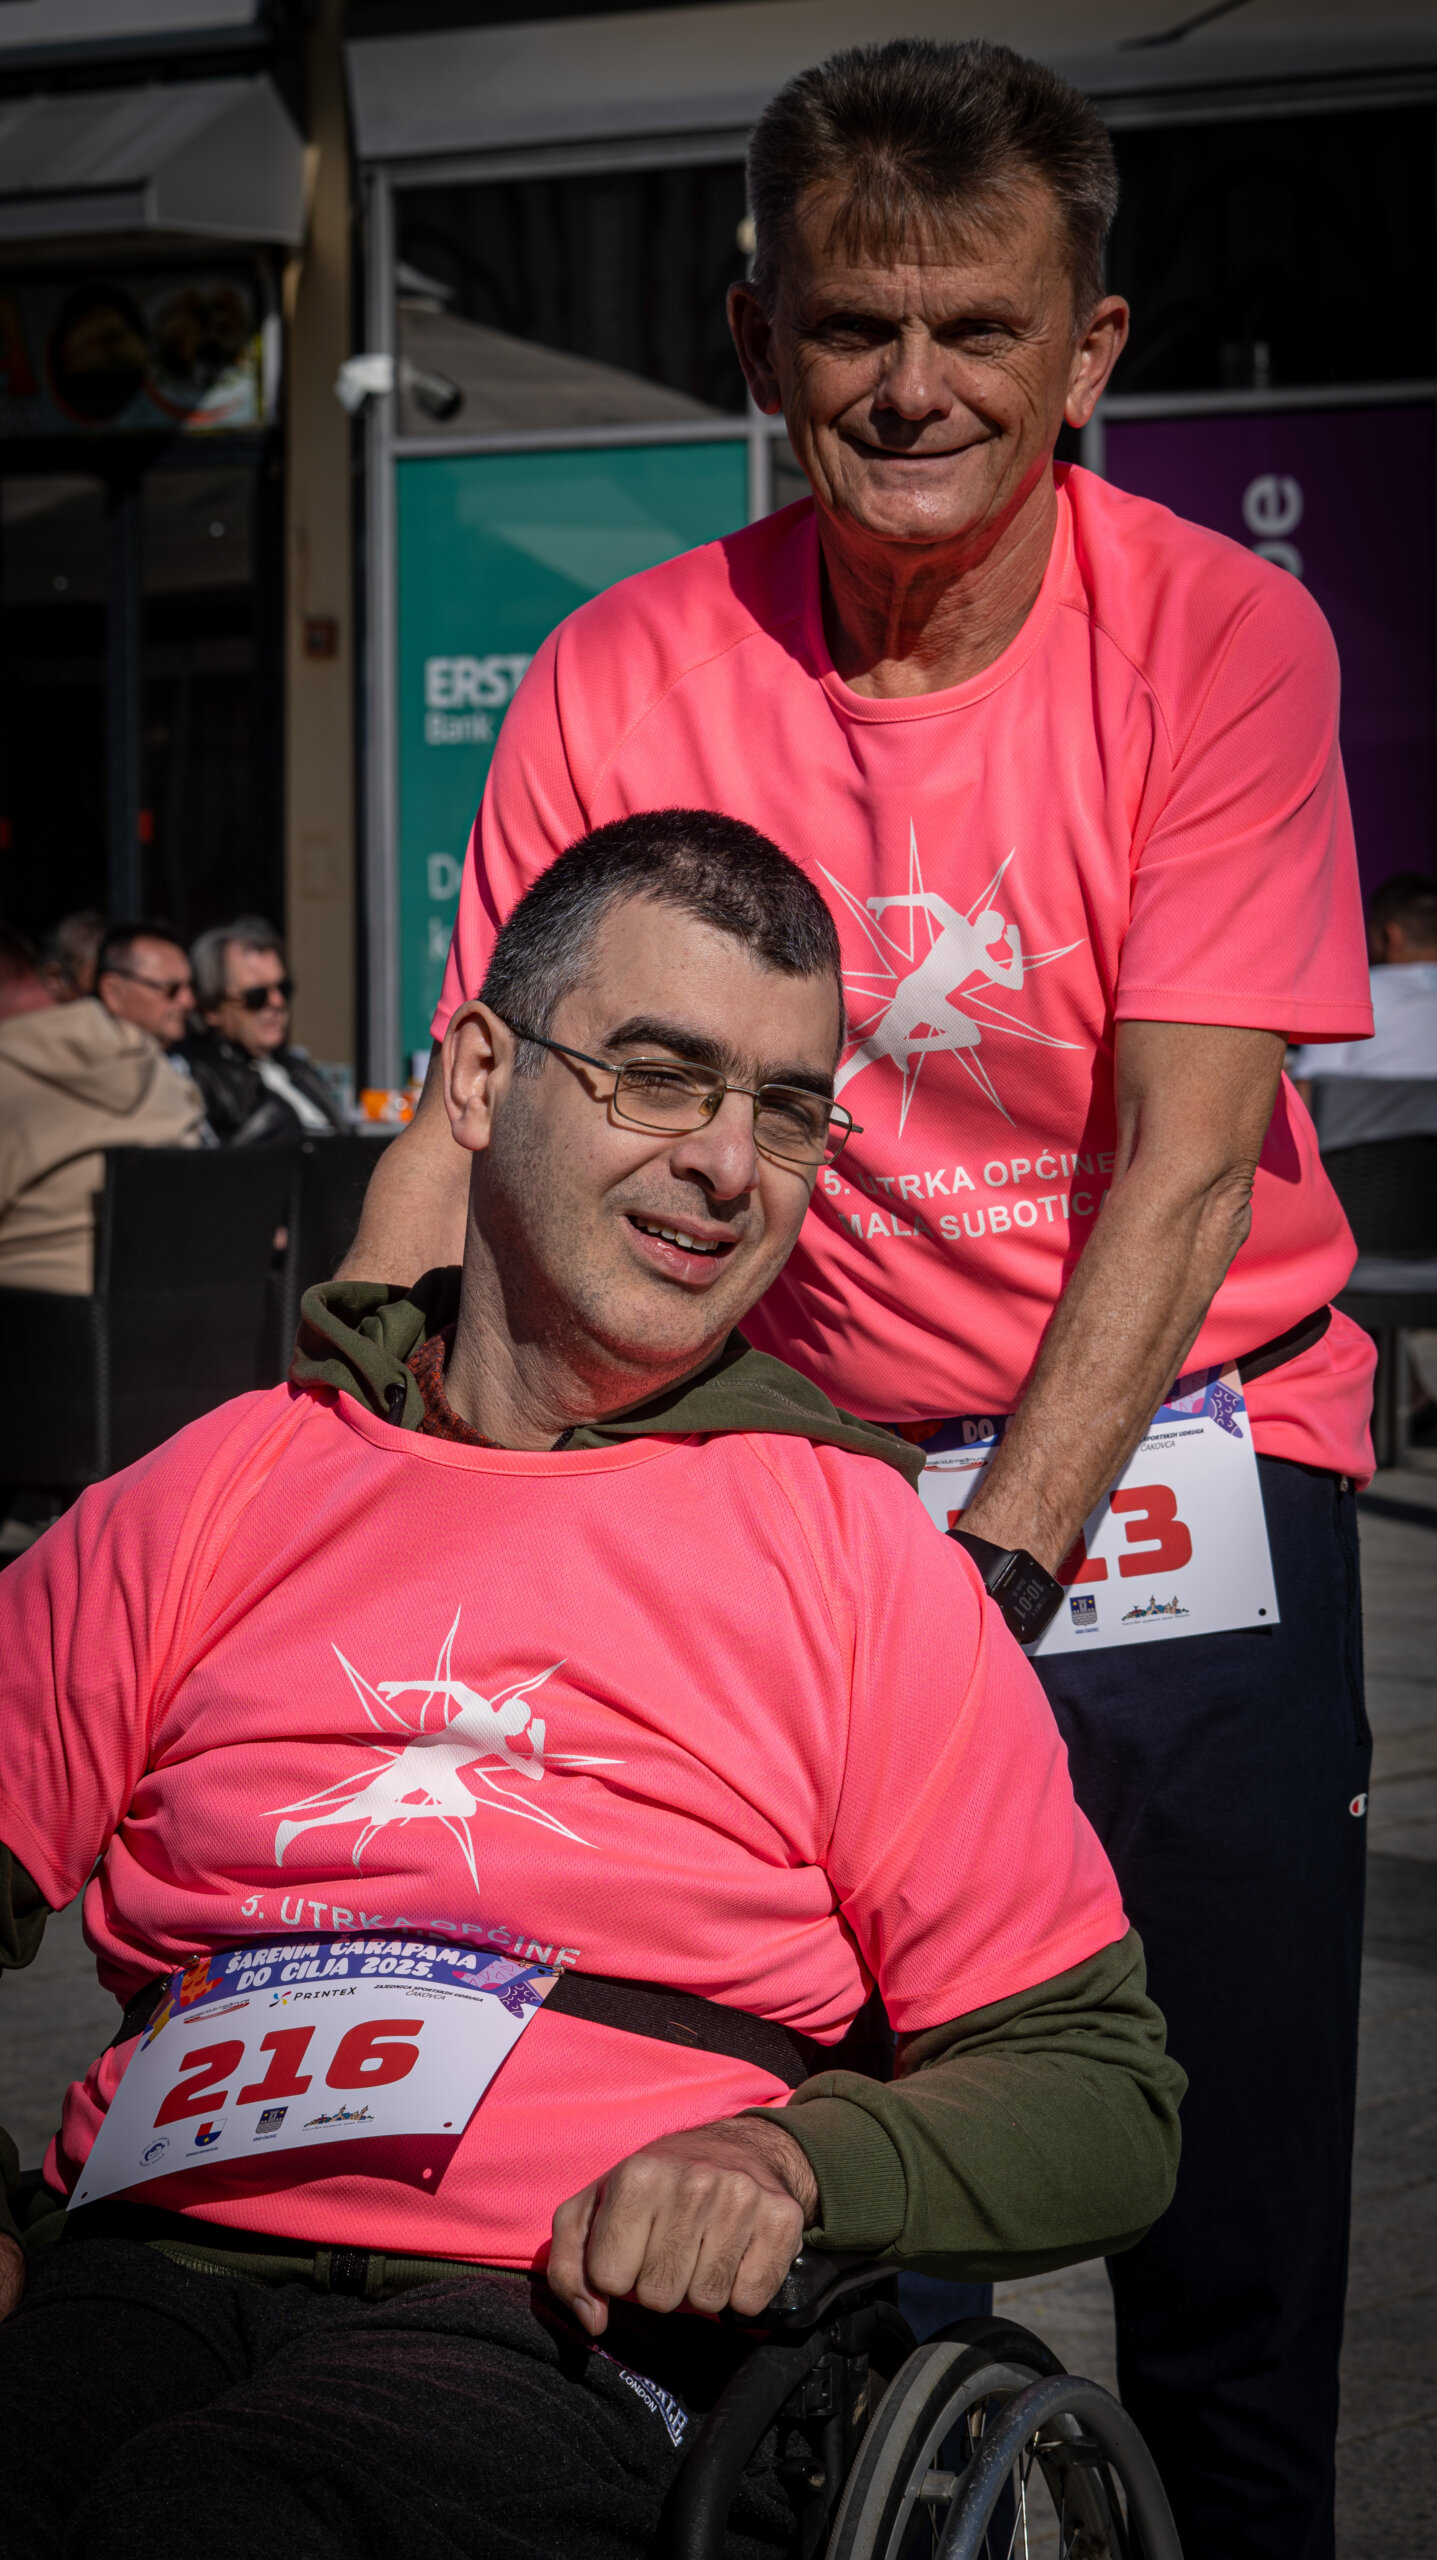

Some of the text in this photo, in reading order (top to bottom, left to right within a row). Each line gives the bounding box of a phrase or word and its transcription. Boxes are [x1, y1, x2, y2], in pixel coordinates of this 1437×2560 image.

[425, 711, 493, 745] Bank
[823, 1149, 1116, 1200] 5. UTRKA OPĆINE
[838, 1211, 935, 1239] MALA
[962, 1418, 995, 1444] DO
[1013, 1579, 1045, 1620] 10:01
[241, 1895, 265, 1919] 5.
[280, 1896, 416, 1930] UTRKA
[226, 1942, 320, 1974] ŠARENIM
[330, 1933, 477, 1970] ČARAPAMA
[236, 1957, 434, 1991] DO CILJA 2025.
[153, 2019, 425, 2128] 216
[619, 2370, 658, 2413] LONDON
